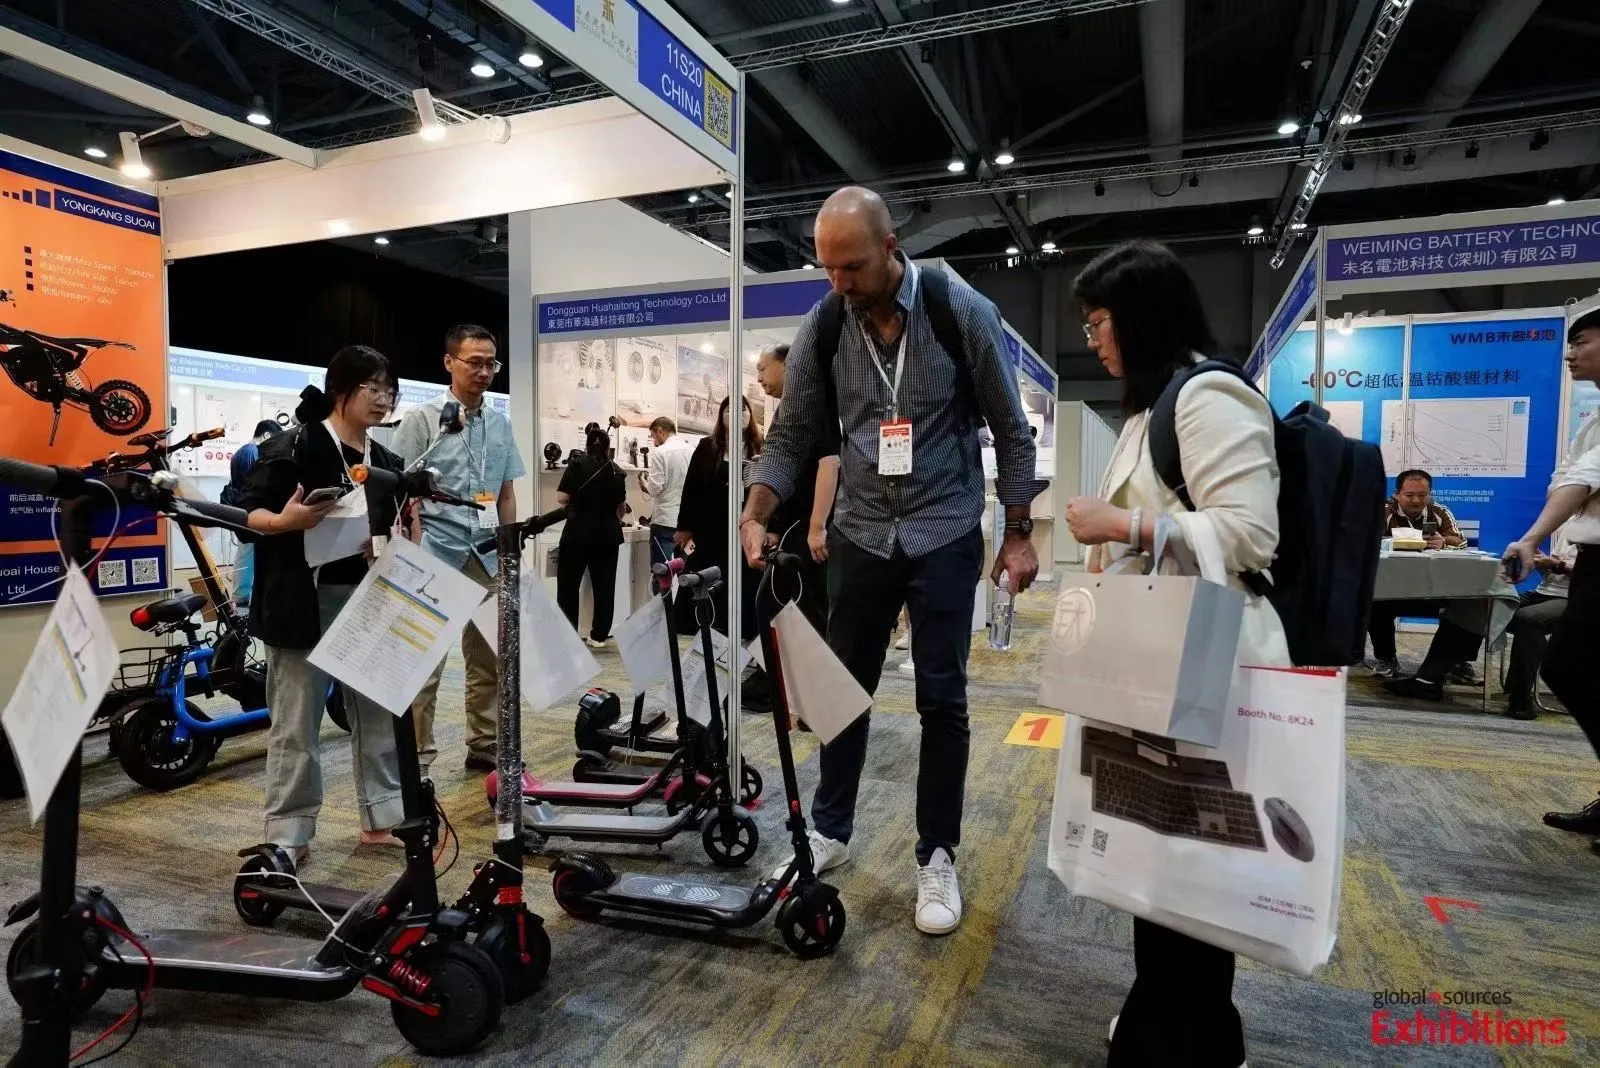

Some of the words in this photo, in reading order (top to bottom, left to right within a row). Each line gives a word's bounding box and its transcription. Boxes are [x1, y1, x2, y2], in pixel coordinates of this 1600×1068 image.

[666, 42, 702, 88] 11S20
[661, 73, 703, 122] CHINA
[61, 197, 122, 222] YONGKANG
[124, 214, 155, 230] SUOAI
[1342, 238, 1423, 256] WEIMING
[1428, 229, 1515, 249] BATTERY
[547, 304, 589, 317] Dongguan
[591, 300, 640, 313] Huahaitong
[643, 295, 693, 309] Technology
[695, 292, 727, 304] Co.Ltd
[24, 565, 60, 575] House
[1237, 707, 1267, 719] Booth
[1024, 717, 1050, 741] 1
